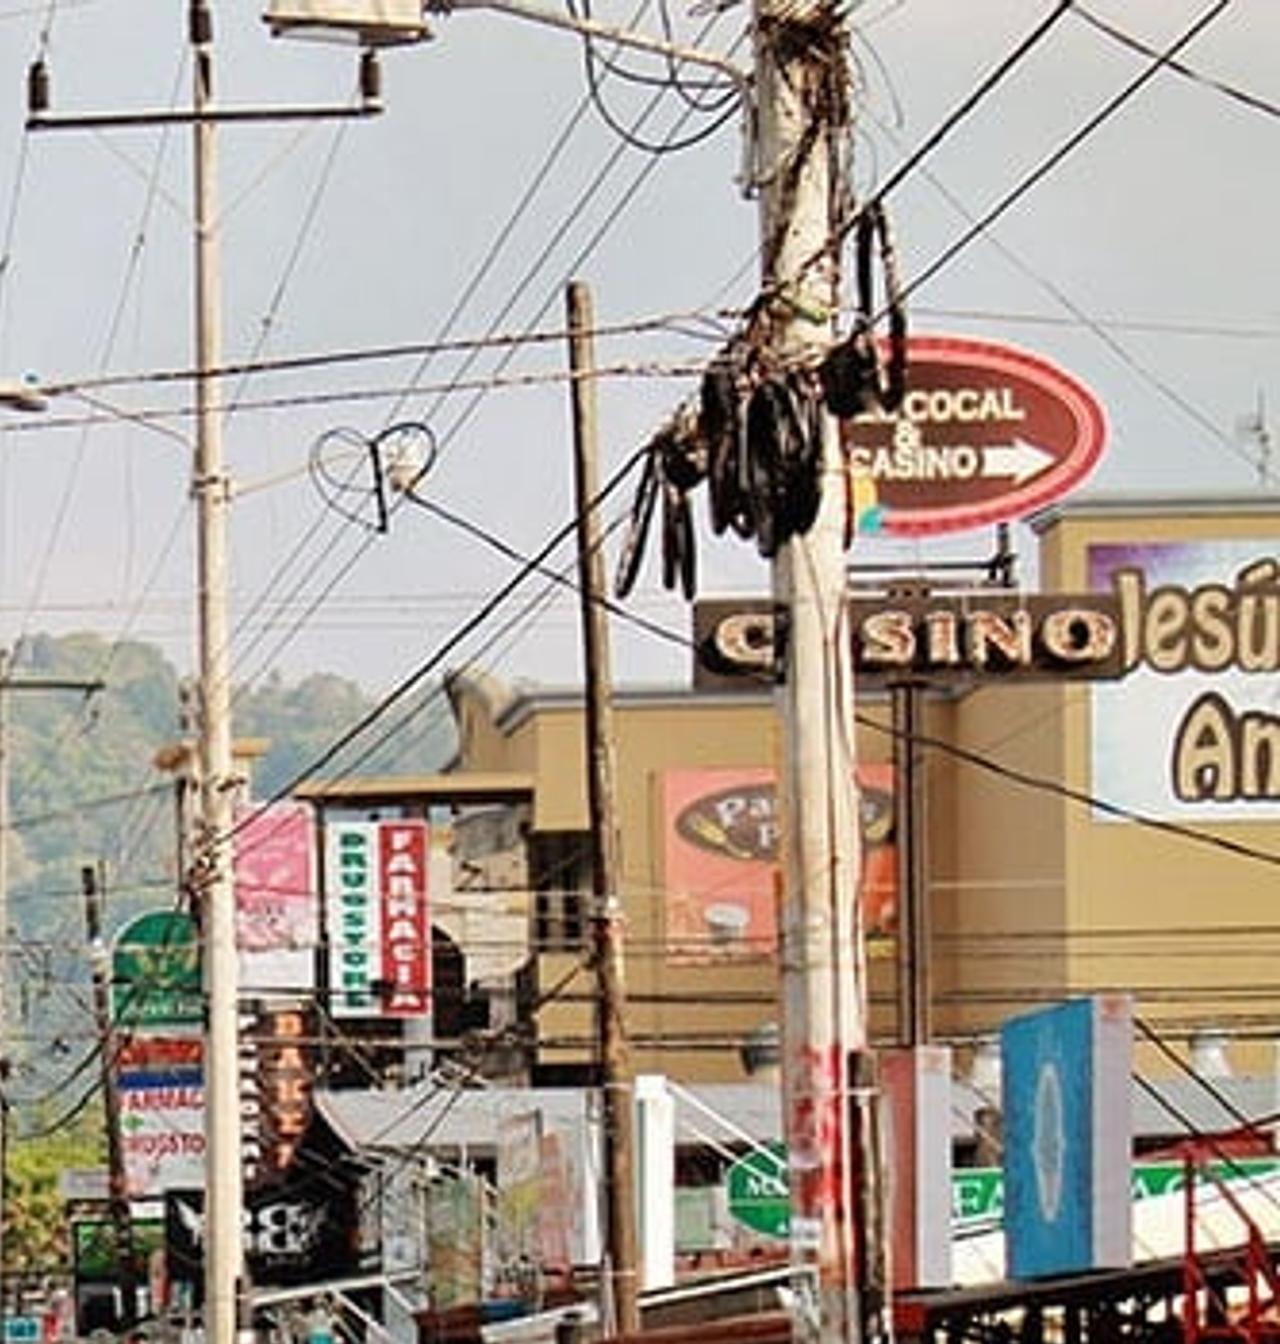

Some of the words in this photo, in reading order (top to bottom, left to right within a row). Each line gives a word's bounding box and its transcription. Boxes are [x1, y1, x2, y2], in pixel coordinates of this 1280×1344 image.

[904, 388, 1025, 421] COCAL
[894, 420, 920, 450] &
[850, 447, 978, 480] CASINO
[715, 610, 1117, 664] CSINO
[388, 830, 421, 1007] FARMACIA
